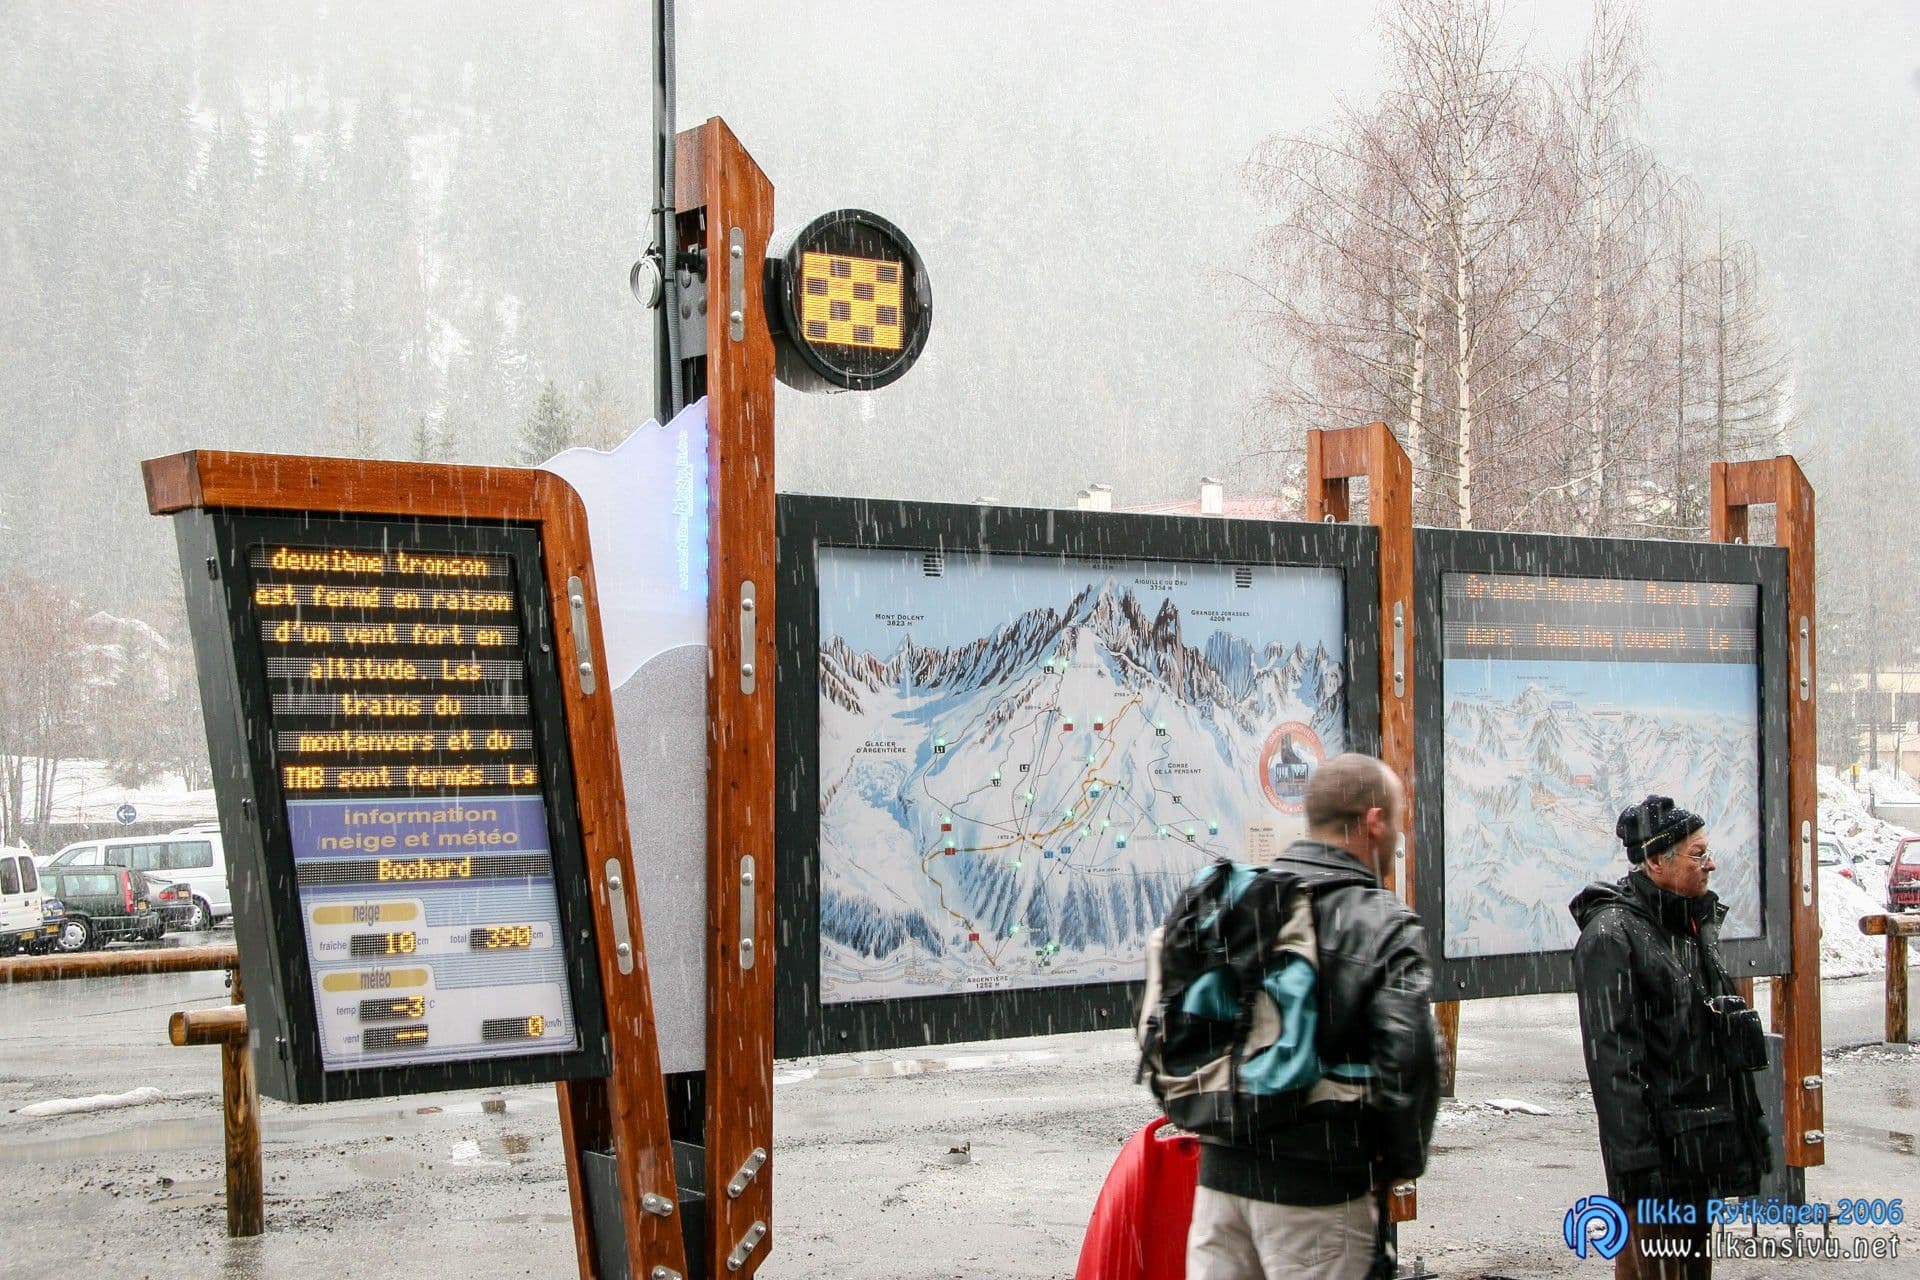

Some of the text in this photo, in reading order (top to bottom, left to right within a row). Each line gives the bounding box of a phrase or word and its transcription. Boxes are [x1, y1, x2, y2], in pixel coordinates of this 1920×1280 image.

[272, 547, 382, 572] deuxième
[255, 584, 513, 611] est fermé en raison
[1646, 581, 1699, 606] Mardi
[274, 621, 502, 645] d'un vent fort en
[1536, 622, 1614, 648] Domaine
[309, 658, 482, 680] altitude. Les
[341, 695, 461, 715] trains du
[299, 730, 512, 752] montenvers et du
[283, 767, 324, 788] TMB
[338, 767, 392, 788] sont
[508, 763, 537, 785] La
[344, 806, 497, 825] information
[320, 828, 519, 852] neige et météo
[377, 856, 473, 881] Bochard
[352, 900, 380, 926] neige
[386, 931, 416, 953] 10
[417, 938, 429, 946] cm
[450, 933, 467, 944] total
[533, 931, 544, 939] cm
[360, 966, 391, 990] météo
[336, 1006, 357, 1016] temp
